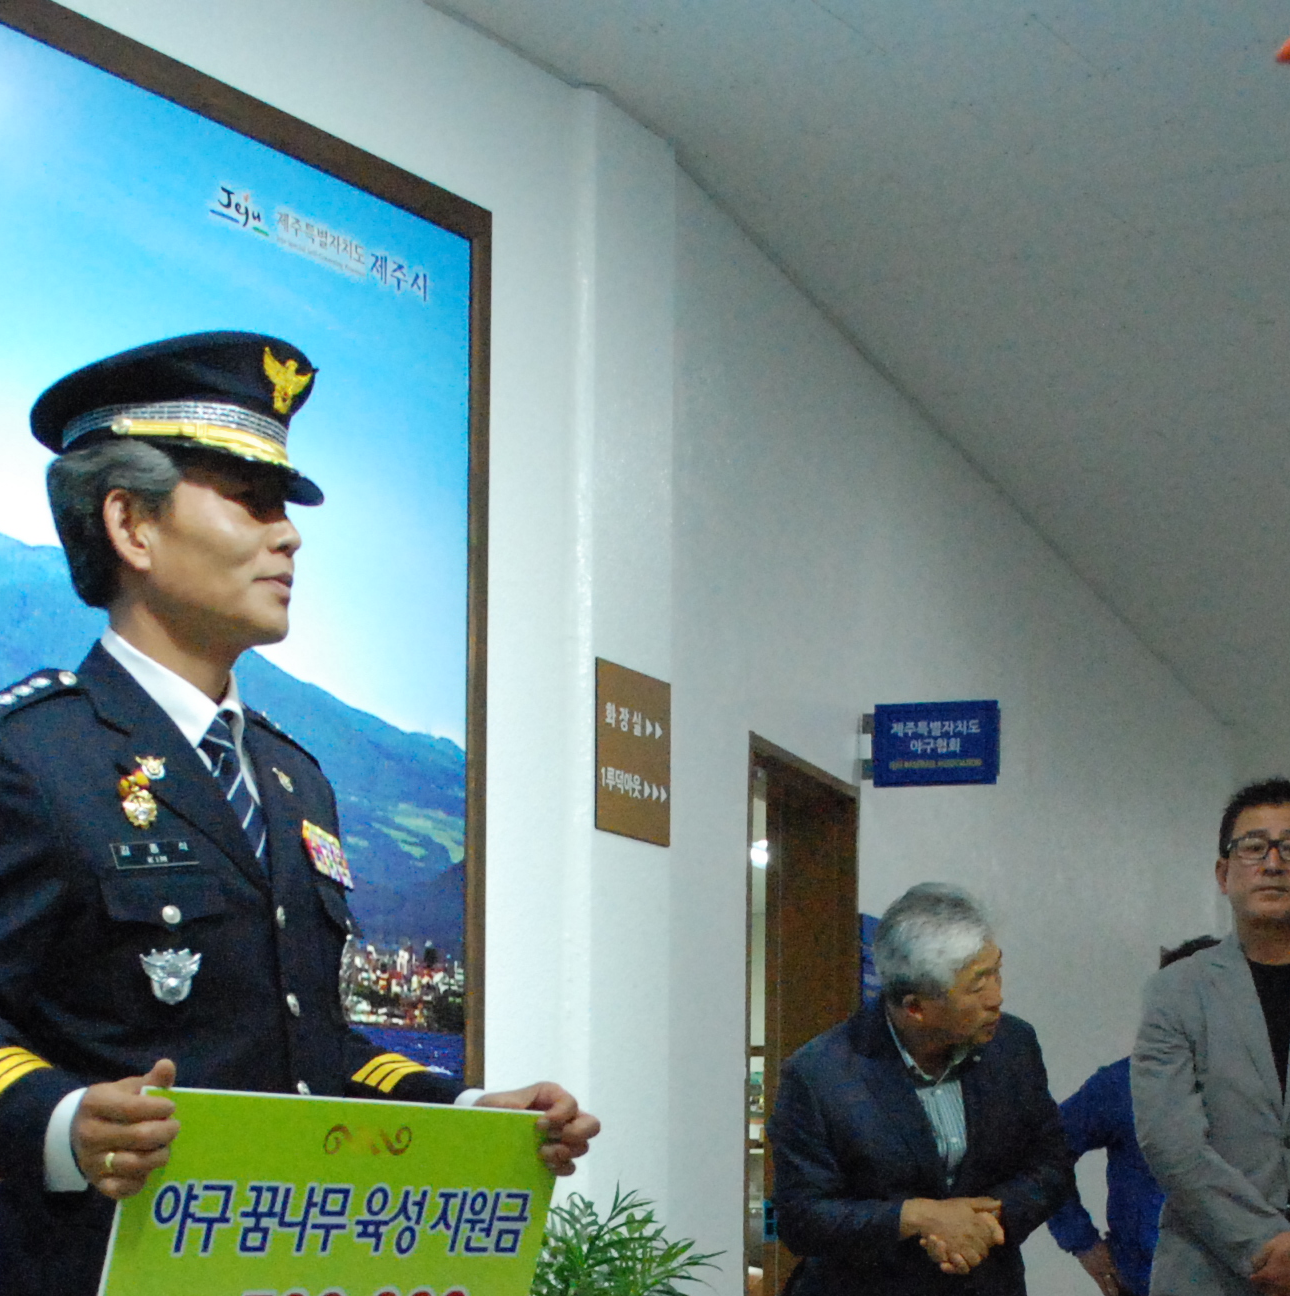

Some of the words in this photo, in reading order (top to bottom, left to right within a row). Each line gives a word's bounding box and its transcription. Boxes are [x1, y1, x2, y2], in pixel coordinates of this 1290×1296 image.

[216, 186, 262, 227] Jeju
[276, 211, 366, 265] 제주특별자치도
[370, 253, 428, 302] 제주시
[604, 702, 642, 737] 화장실
[890, 719, 982, 738] 제주특별자치도
[909, 737, 961, 754] 야구협회
[600, 766, 642, 799] 1루덕아웃
[153, 1183, 234, 1253] 야구
[239, 1185, 352, 1253] 꿈나무
[356, 1187, 429, 1255] 육성
[429, 1190, 531, 1255] 지원금
